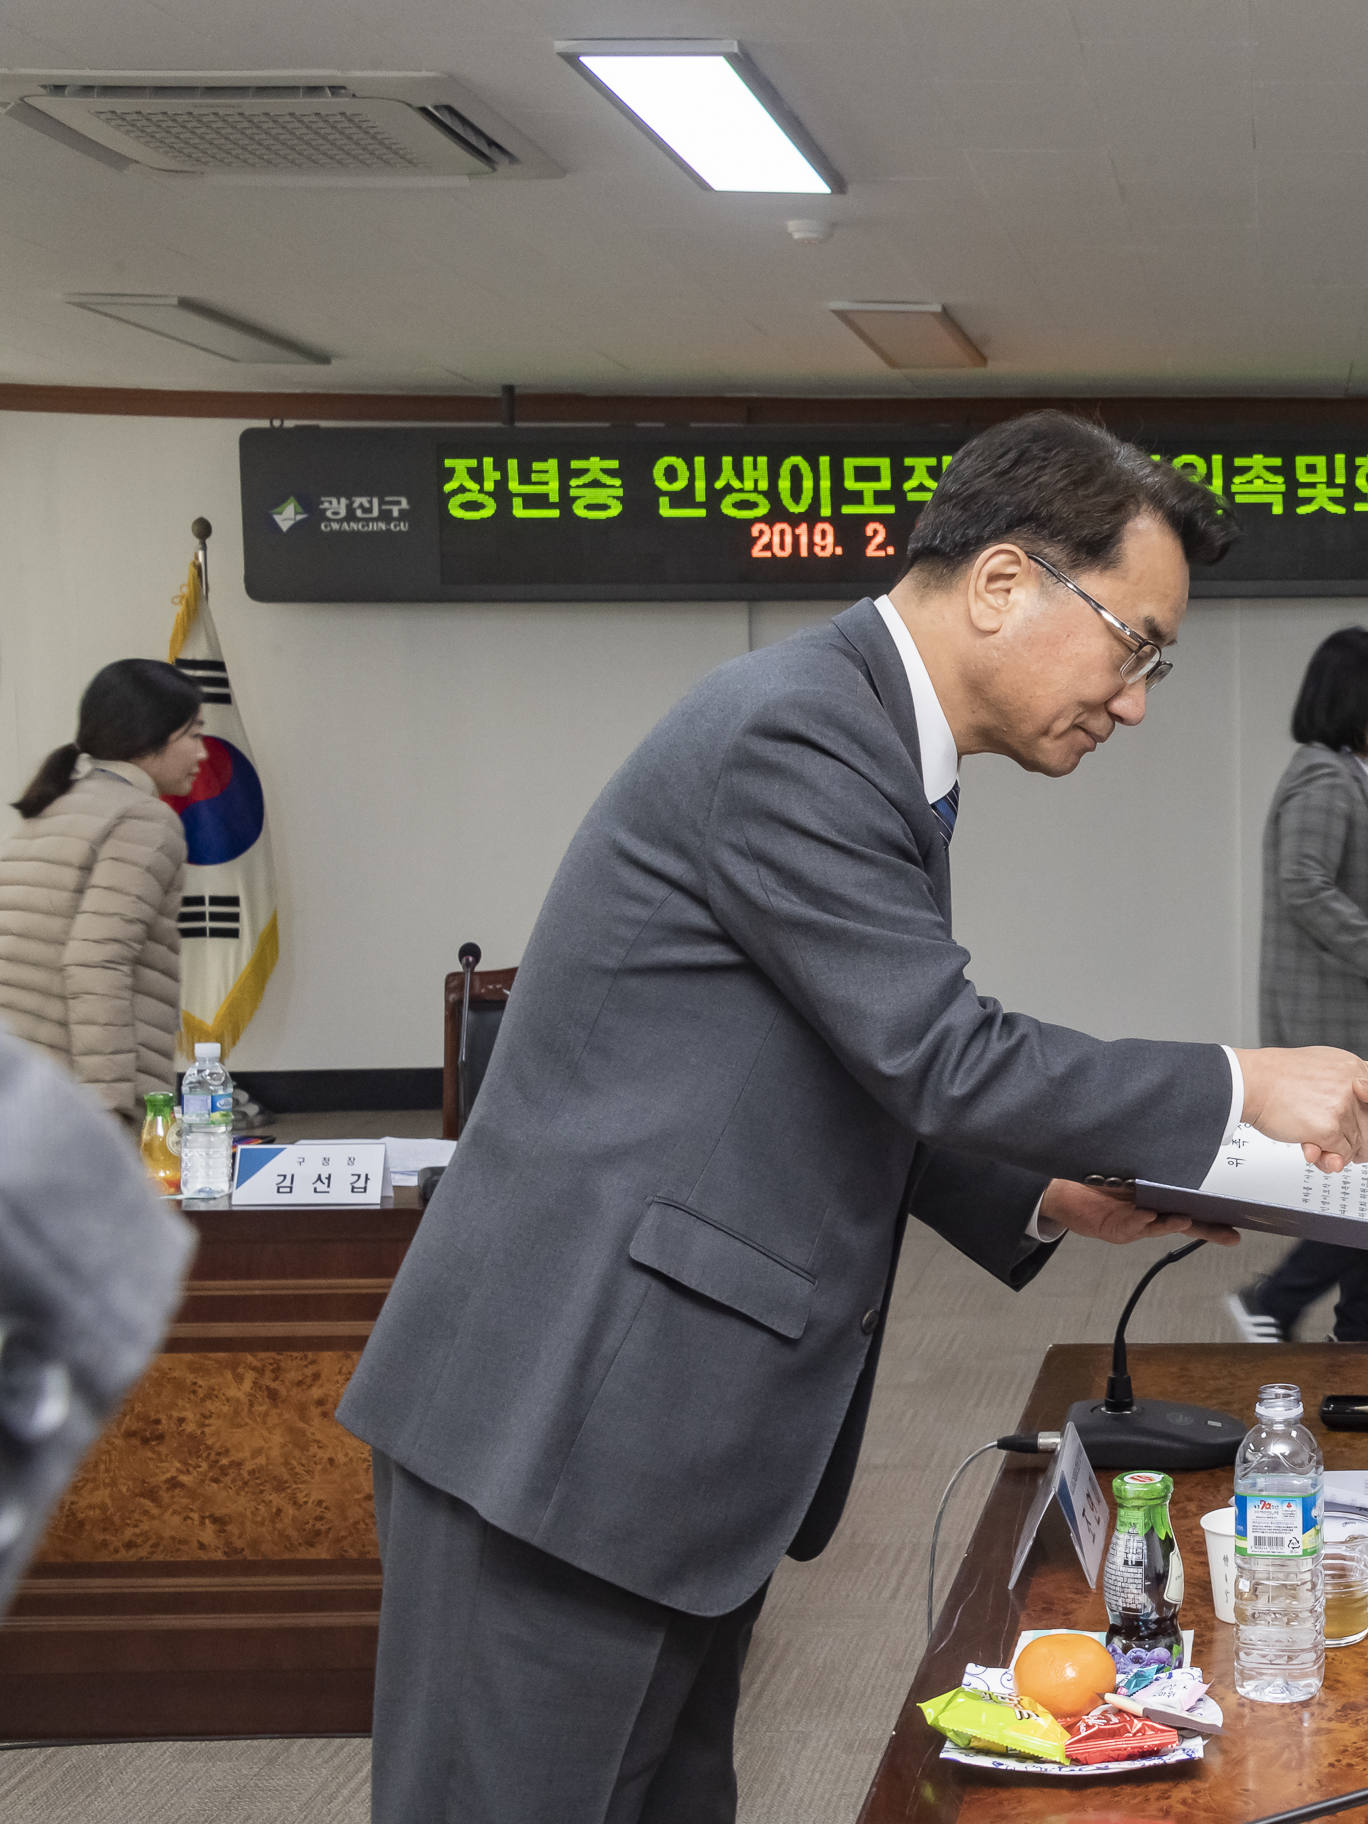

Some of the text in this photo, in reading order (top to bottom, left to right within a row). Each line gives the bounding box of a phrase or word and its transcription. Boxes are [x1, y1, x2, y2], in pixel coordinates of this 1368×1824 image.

[443, 456, 624, 520] 장년층
[319, 496, 410, 519] 광진구
[320, 520, 409, 532] GWANGJIN-GU
[750, 522, 895, 557] 2019. 2.
[275, 1173, 371, 1194] 김선갑
